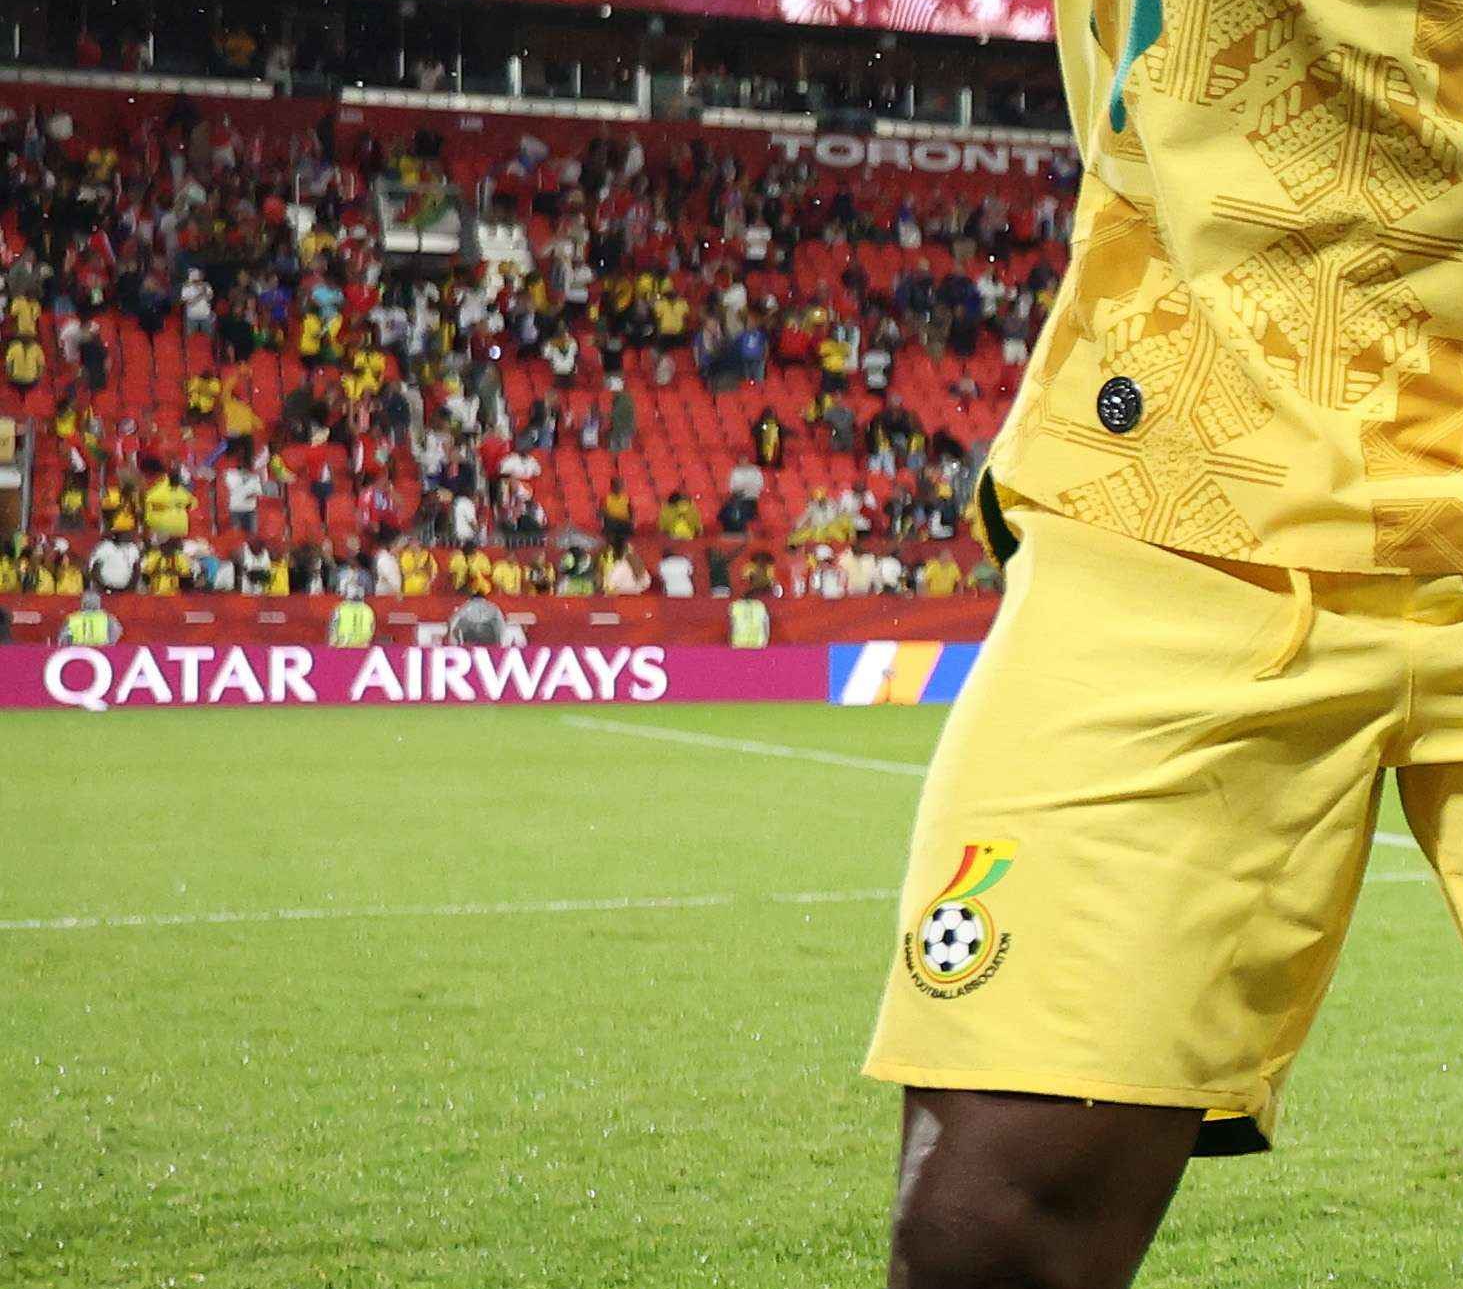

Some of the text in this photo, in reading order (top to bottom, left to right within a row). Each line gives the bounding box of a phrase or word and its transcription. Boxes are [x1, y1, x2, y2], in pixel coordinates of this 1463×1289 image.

[771, 132, 1080, 177] TORONT
[44, 646, 668, 711] QATAR AIRWAYS
